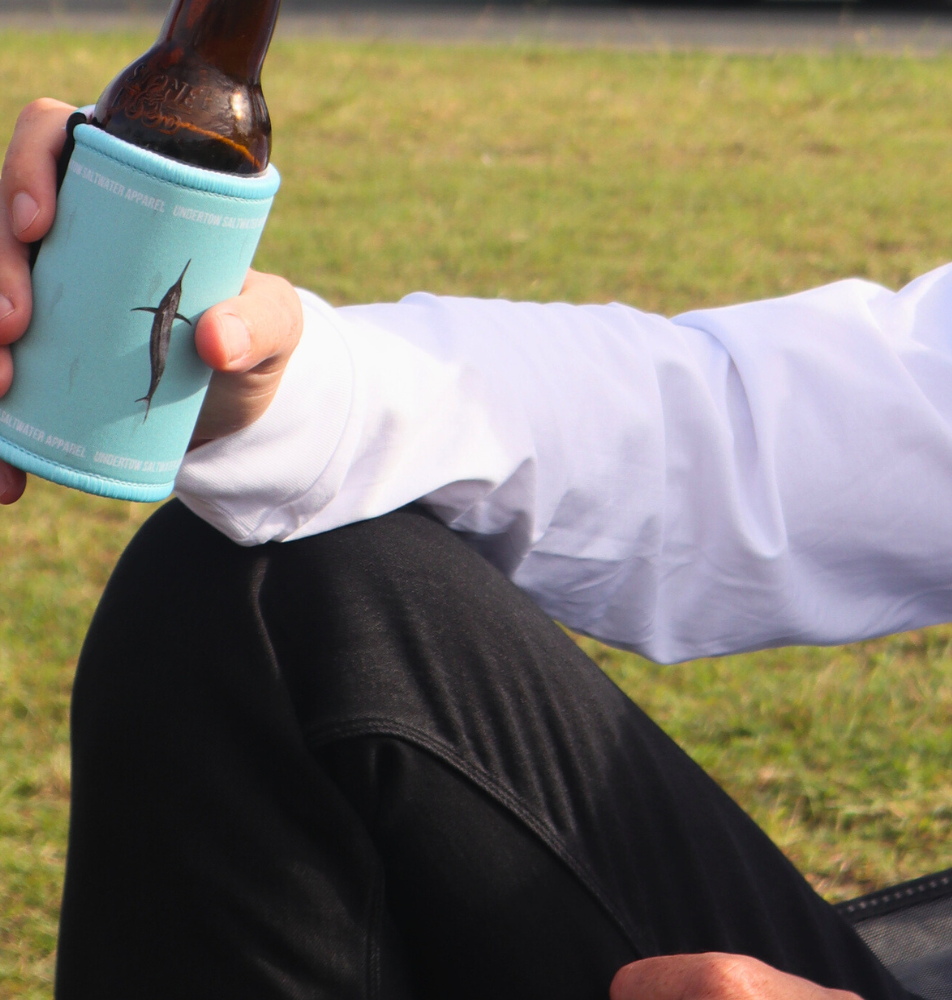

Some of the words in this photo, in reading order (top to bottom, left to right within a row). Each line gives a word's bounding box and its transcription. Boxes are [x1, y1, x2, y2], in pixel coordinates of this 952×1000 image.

[82, 167, 125, 198] SALTWATER
[125, 188, 165, 213] APPAREL
[172, 204, 222, 227] UNDERTOW
[45, 434, 87, 458] APPAREL
[94, 451, 142, 471] UNDERTOW
